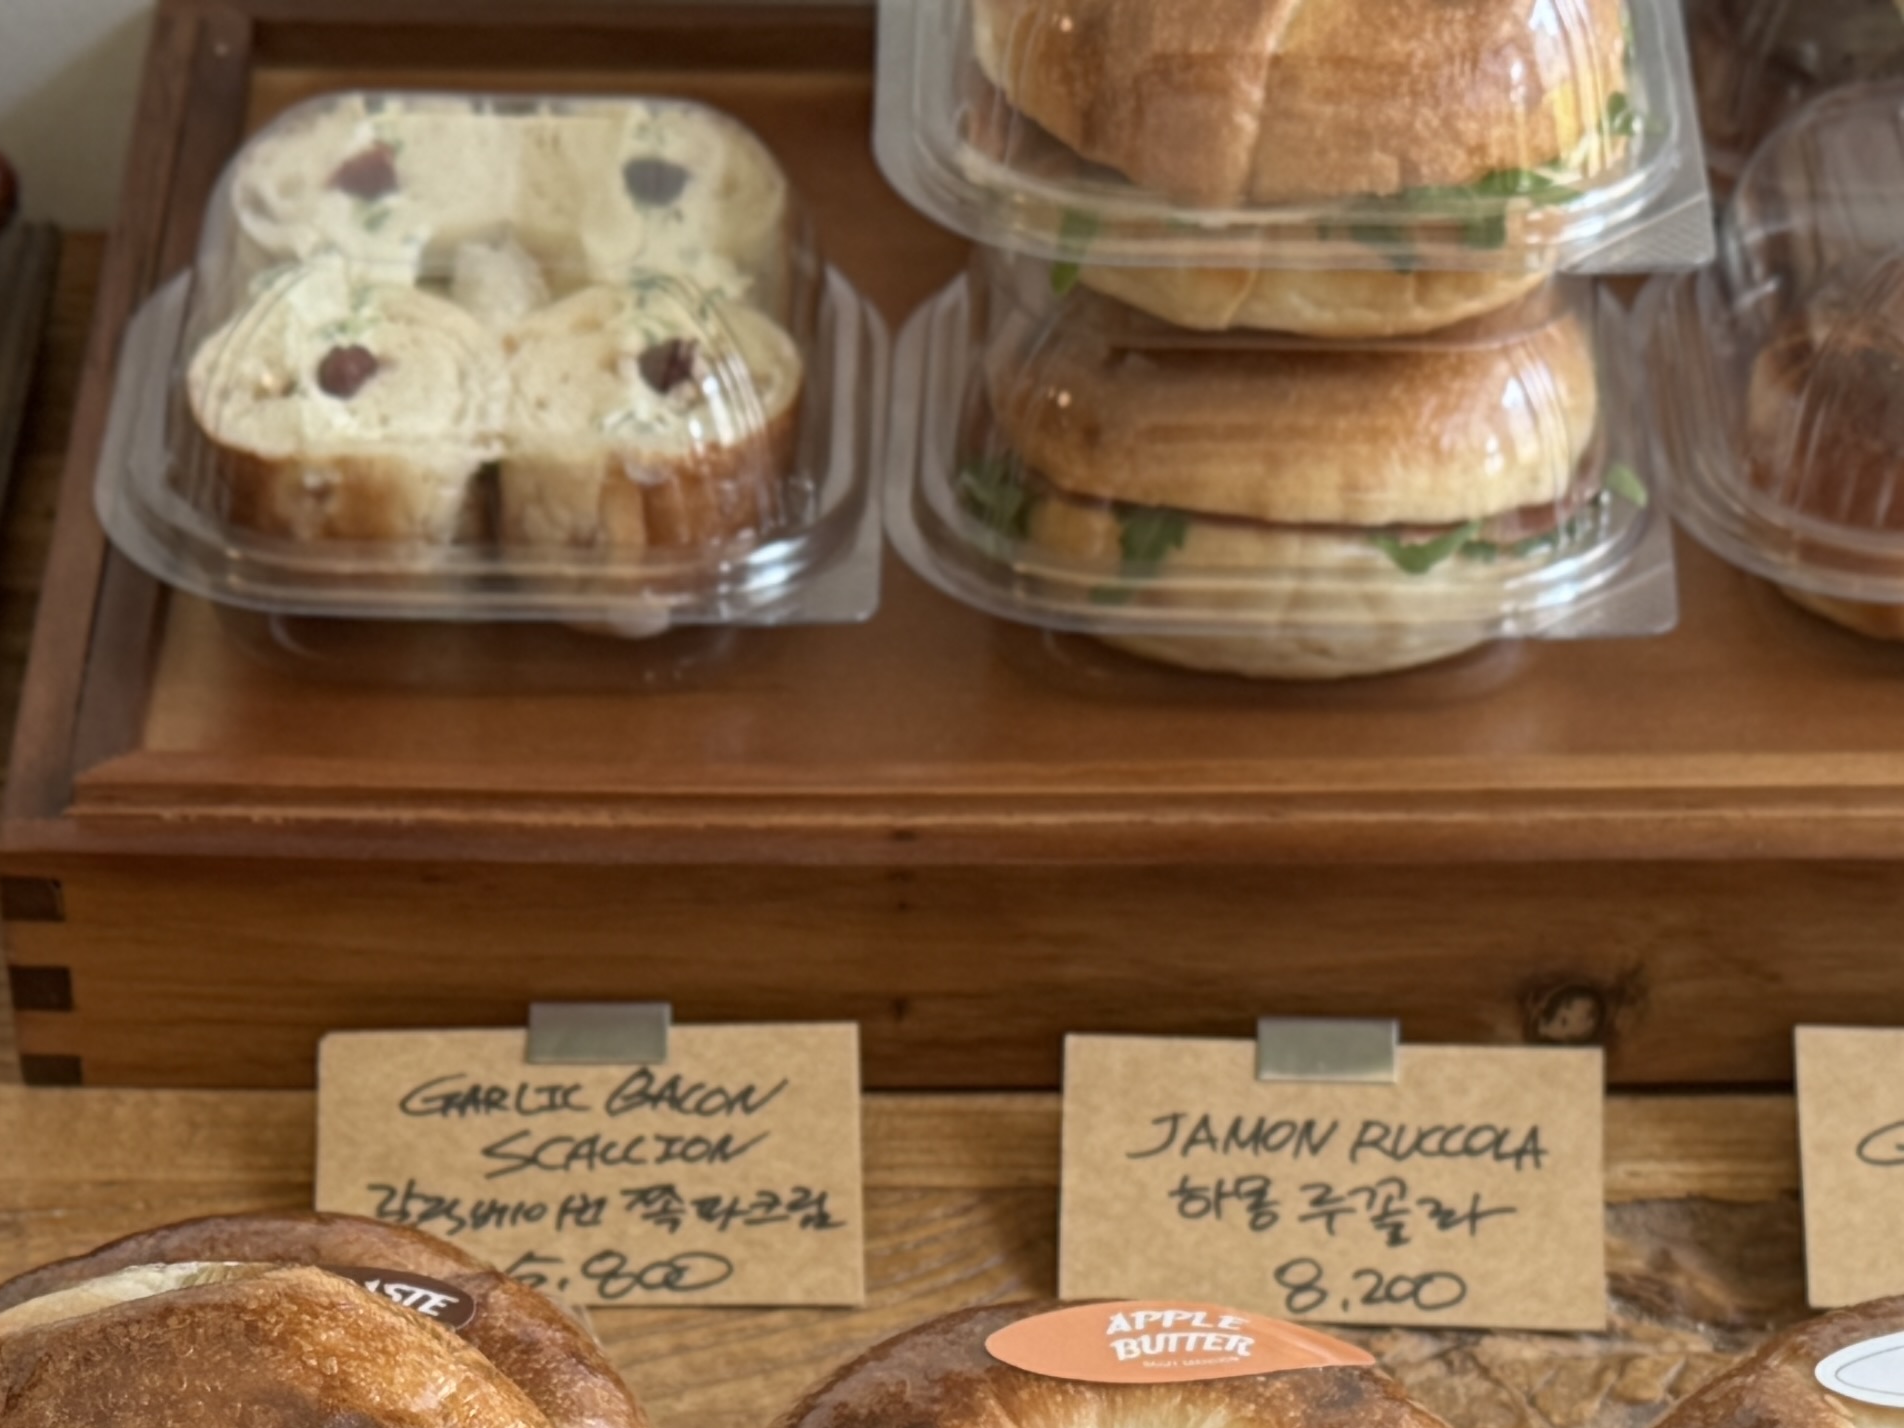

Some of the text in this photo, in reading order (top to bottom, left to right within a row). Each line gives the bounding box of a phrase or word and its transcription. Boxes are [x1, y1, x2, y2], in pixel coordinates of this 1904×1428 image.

[399, 1066, 790, 1119] GARLIC BACON
[1125, 1112, 1550, 1170] JAMON RUCCOLA
[1106, 1309, 1251, 1335] APPLE
[1109, 1331, 1255, 1361] BUTTER
